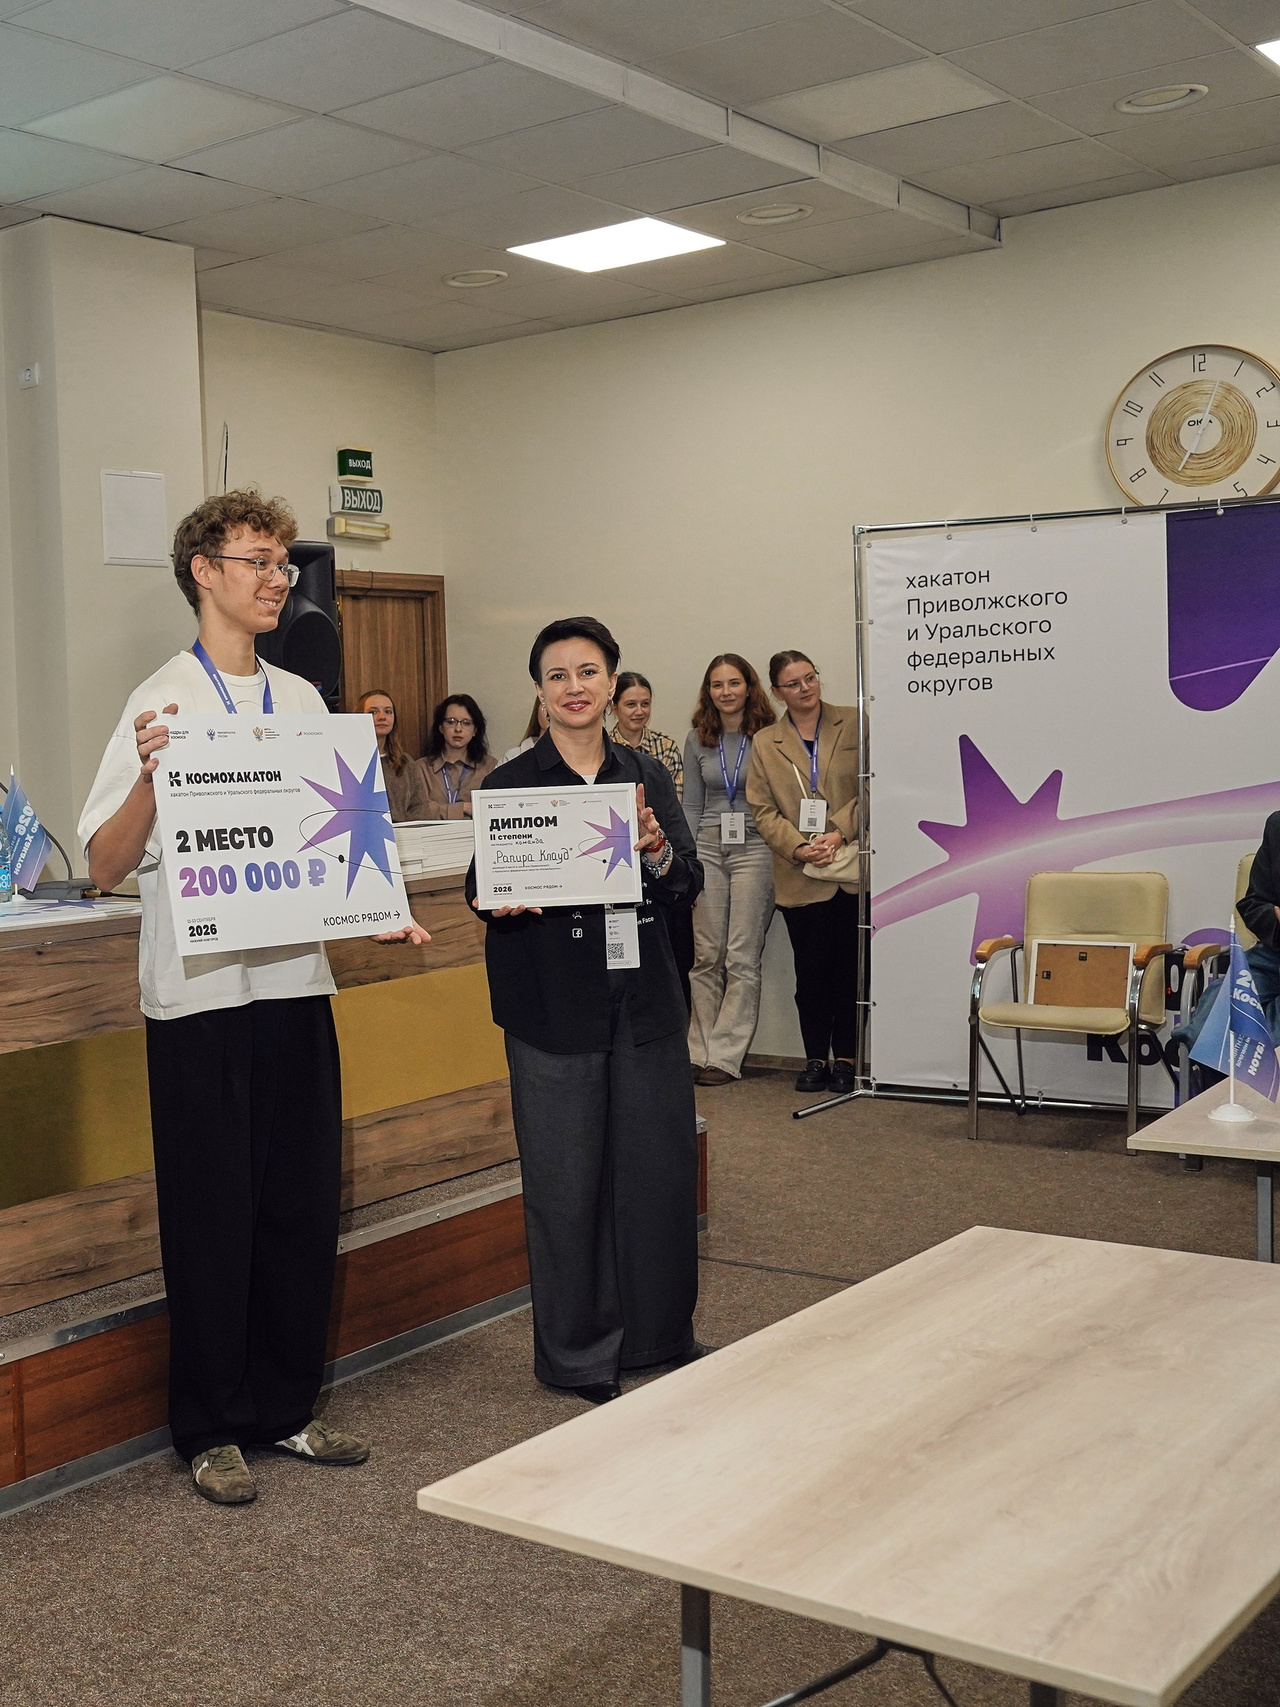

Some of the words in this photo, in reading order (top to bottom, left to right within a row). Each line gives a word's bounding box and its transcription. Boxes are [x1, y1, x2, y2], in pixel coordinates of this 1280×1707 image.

[1192, 353, 1206, 373] 12
[1256, 382, 1276, 398] 2
[1122, 400, 1144, 418] 10
[348, 458, 371, 470] ВЫХОД
[1129, 468, 1147, 483] 8
[343, 488, 381, 512] ВЫХОД
[906, 570, 990, 589] хакатон
[907, 591, 1068, 618] Приволжского
[907, 628, 919, 641] и
[925, 619, 1052, 643] Уральского
[907, 646, 1056, 671] федеральных
[907, 677, 994, 696] округов
[185, 770, 282, 785] КОСМОХАКАТОН
[189, 790, 222, 798] Приволжского
[227, 789, 253, 797] Уральского
[254, 788, 283, 796] федеральных
[489, 815, 558, 832] ДИПЛОМ
[176, 829, 191, 853] 2
[195, 826, 274, 852] МЕСТО
[497, 833, 533, 841] степени
[179, 864, 238, 898] 200
[244, 859, 301, 892] 000
[323, 914, 360, 926] КОСМОС
[361, 911, 392, 922] РЯДОМ
[188, 923, 218, 937] 2026
